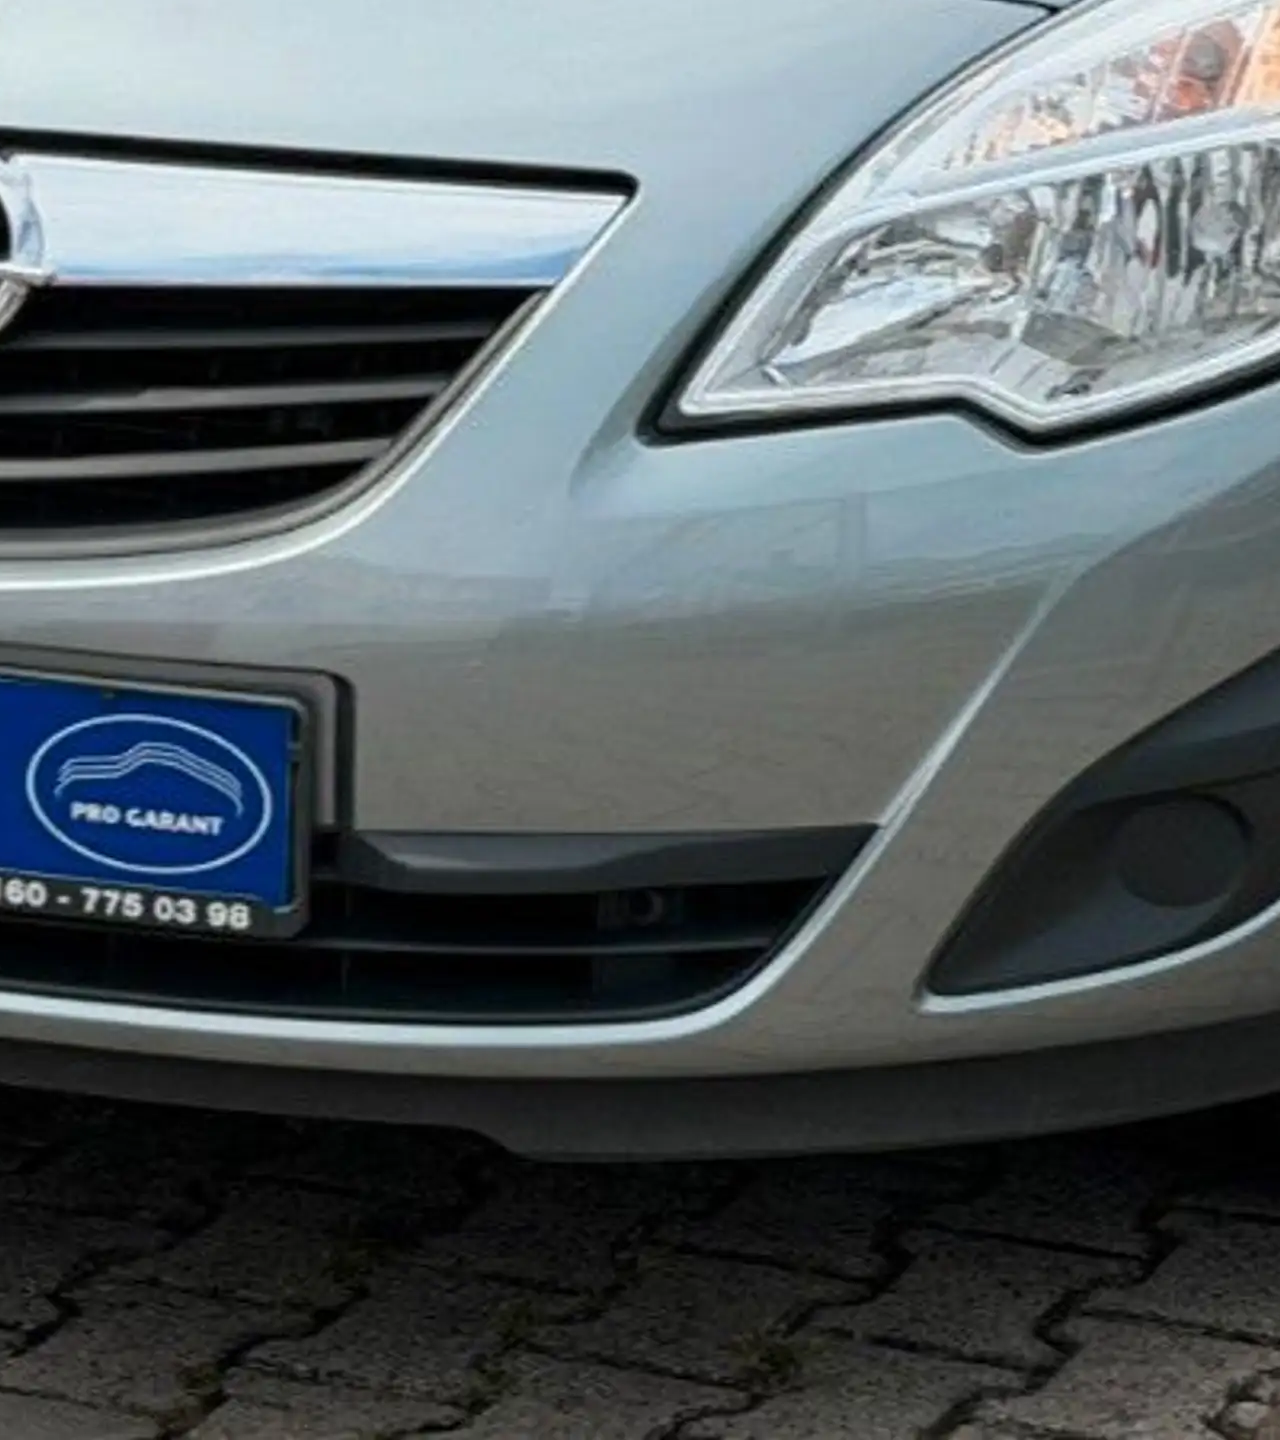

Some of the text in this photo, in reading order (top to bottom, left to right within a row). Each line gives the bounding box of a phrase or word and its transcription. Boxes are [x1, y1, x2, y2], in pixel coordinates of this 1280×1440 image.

[71, 801, 222, 836] PRO GARANT
[81, 887, 143, 919] 775
[153, 896, 197, 925] 03
[206, 903, 252, 931] 98
